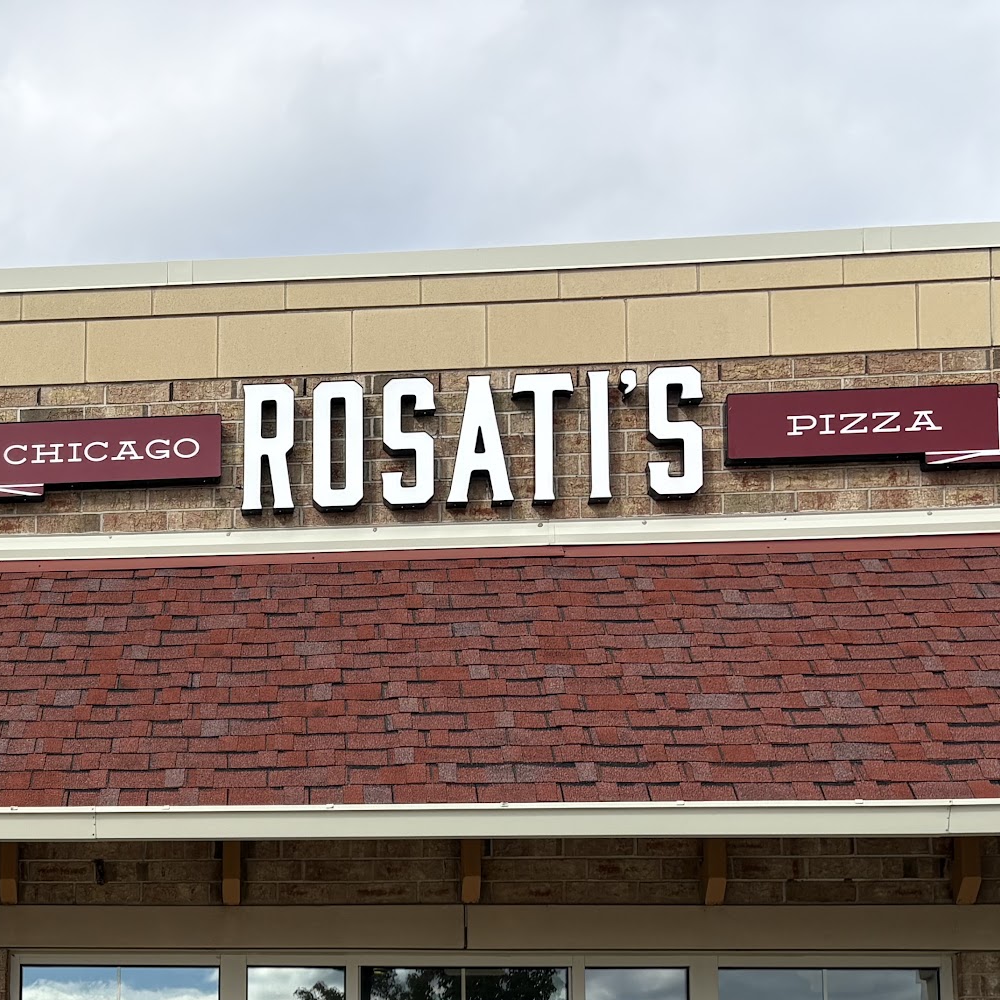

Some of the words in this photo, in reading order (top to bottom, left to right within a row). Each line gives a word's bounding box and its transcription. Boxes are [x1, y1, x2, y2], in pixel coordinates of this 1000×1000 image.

[3, 437, 200, 465] CHICAGO
[241, 366, 704, 513] ROSATI'S
[786, 410, 943, 436] PIZZA
